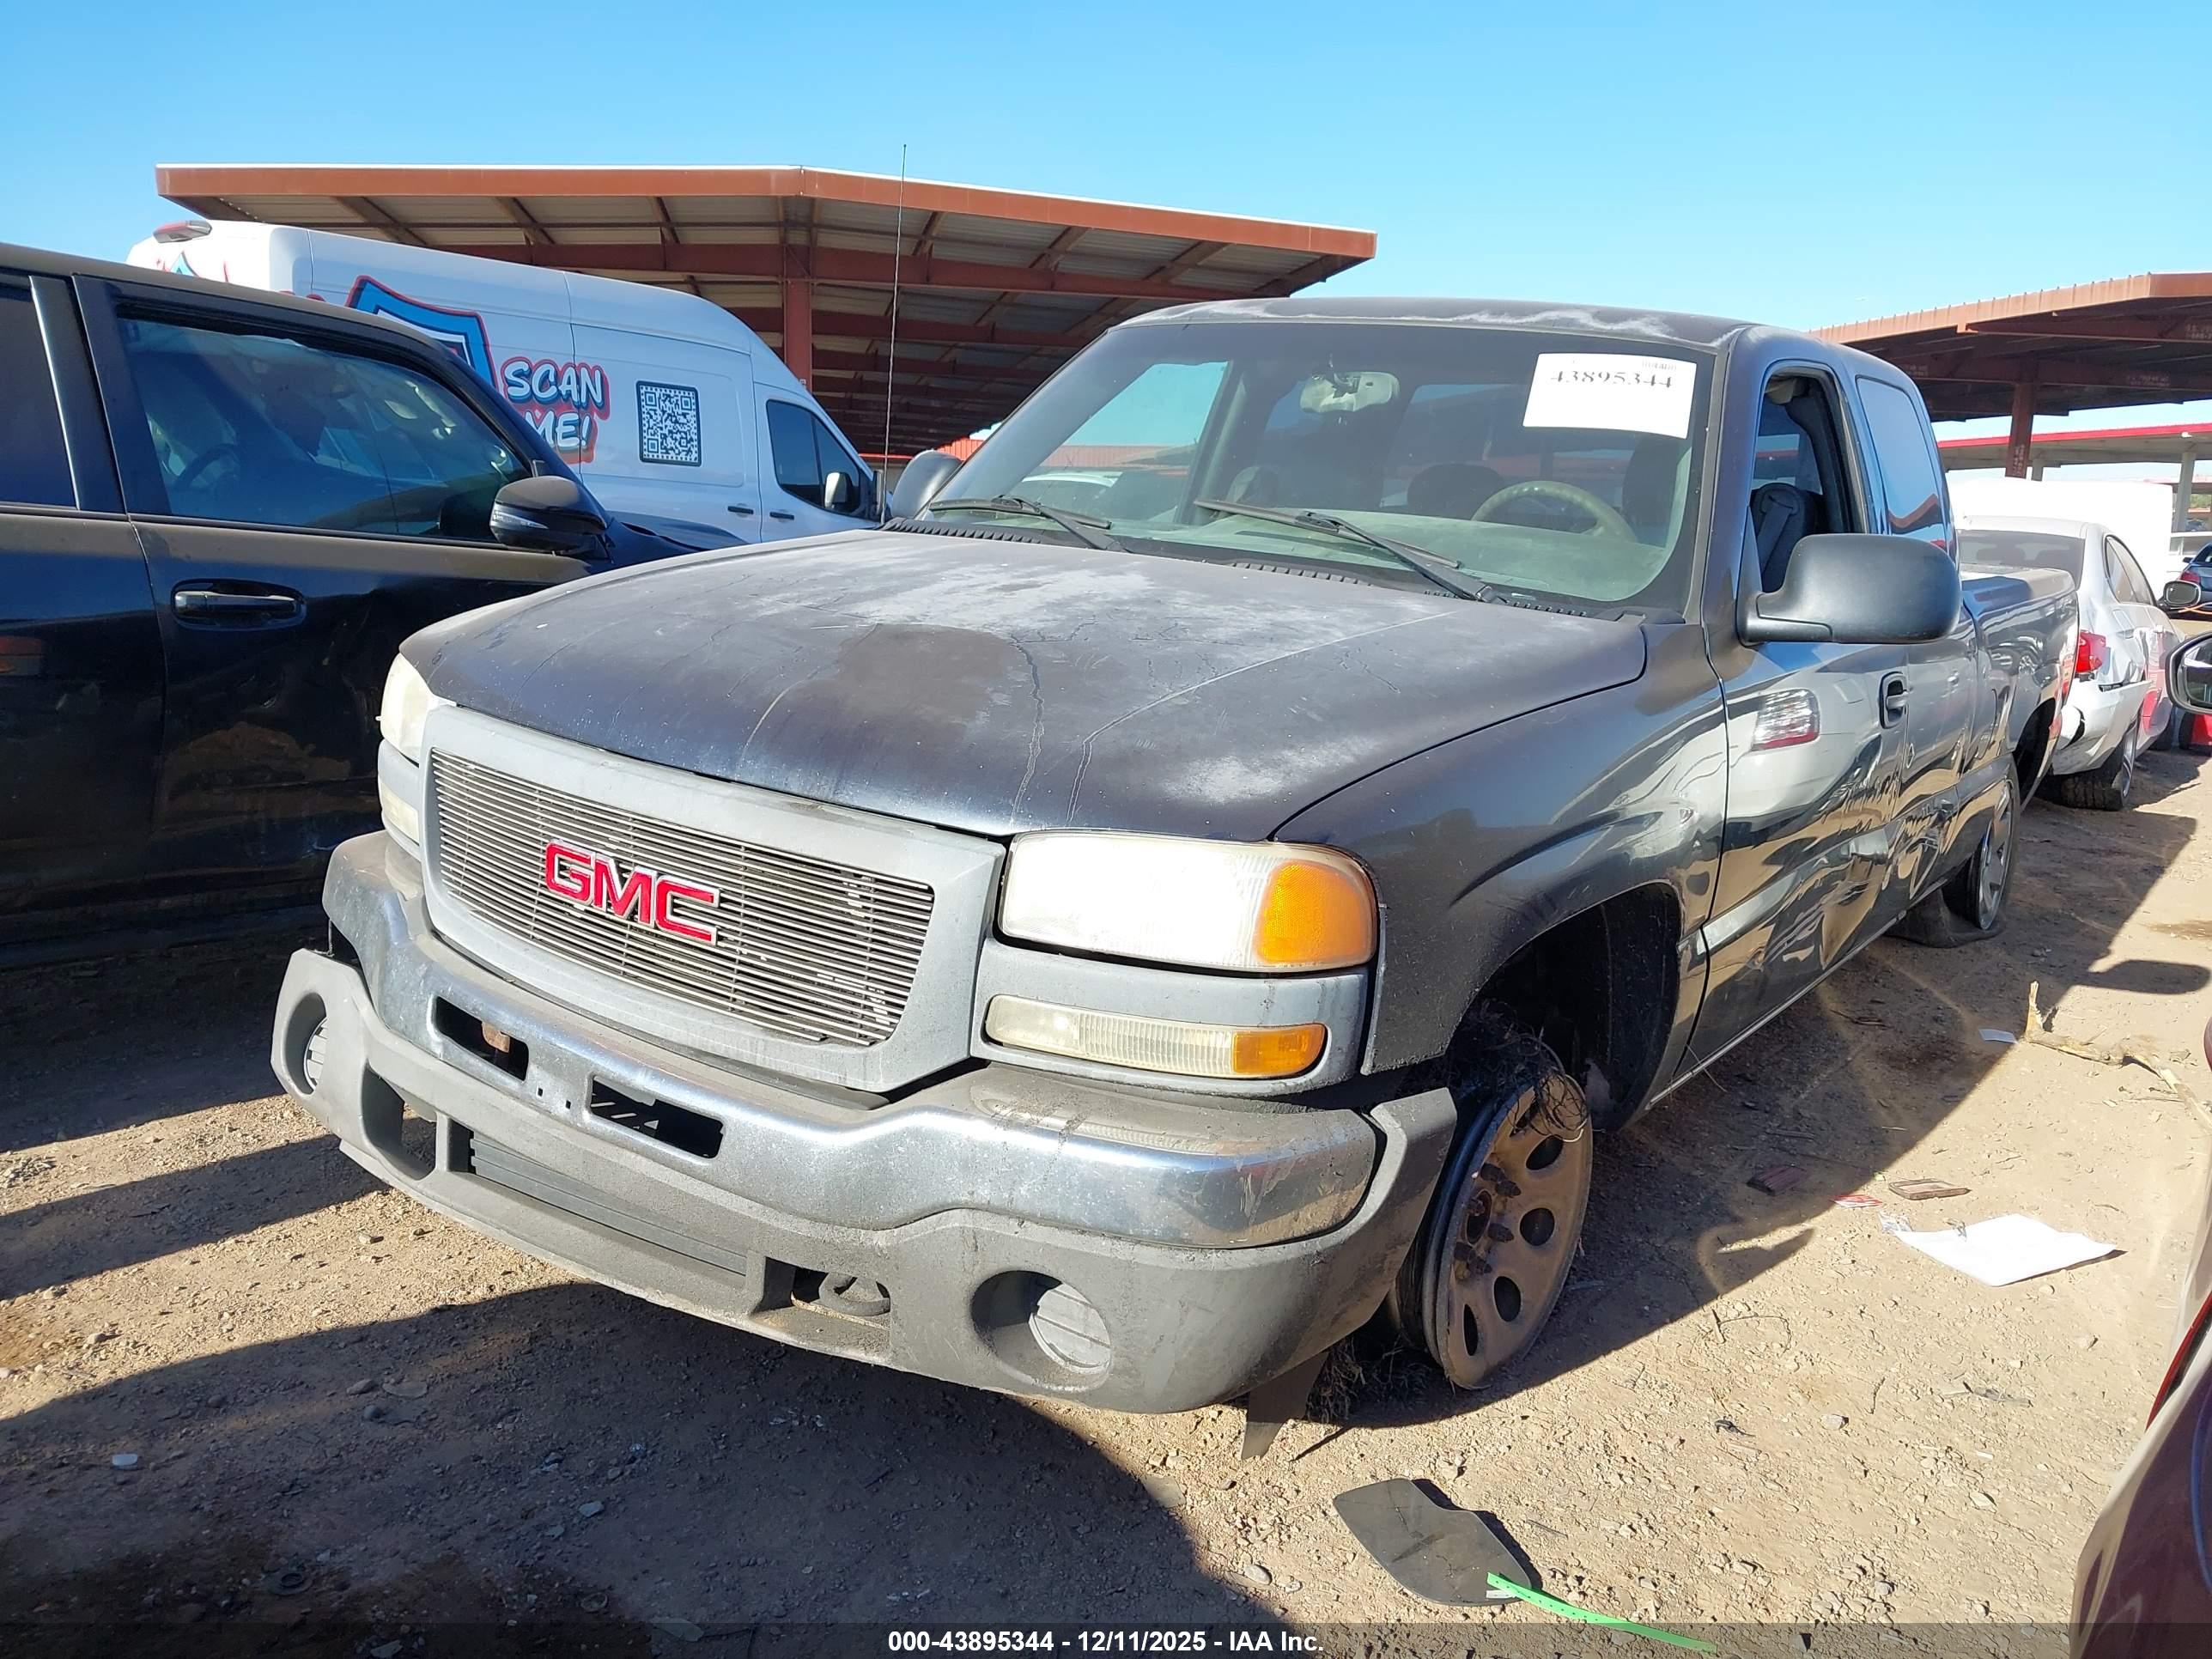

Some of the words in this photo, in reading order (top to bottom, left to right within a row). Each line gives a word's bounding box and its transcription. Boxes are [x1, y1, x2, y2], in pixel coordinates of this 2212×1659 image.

[503, 360, 604, 408] SCAN
[1550, 370, 1673, 388] 43895344
[544, 838, 721, 946] GMC
